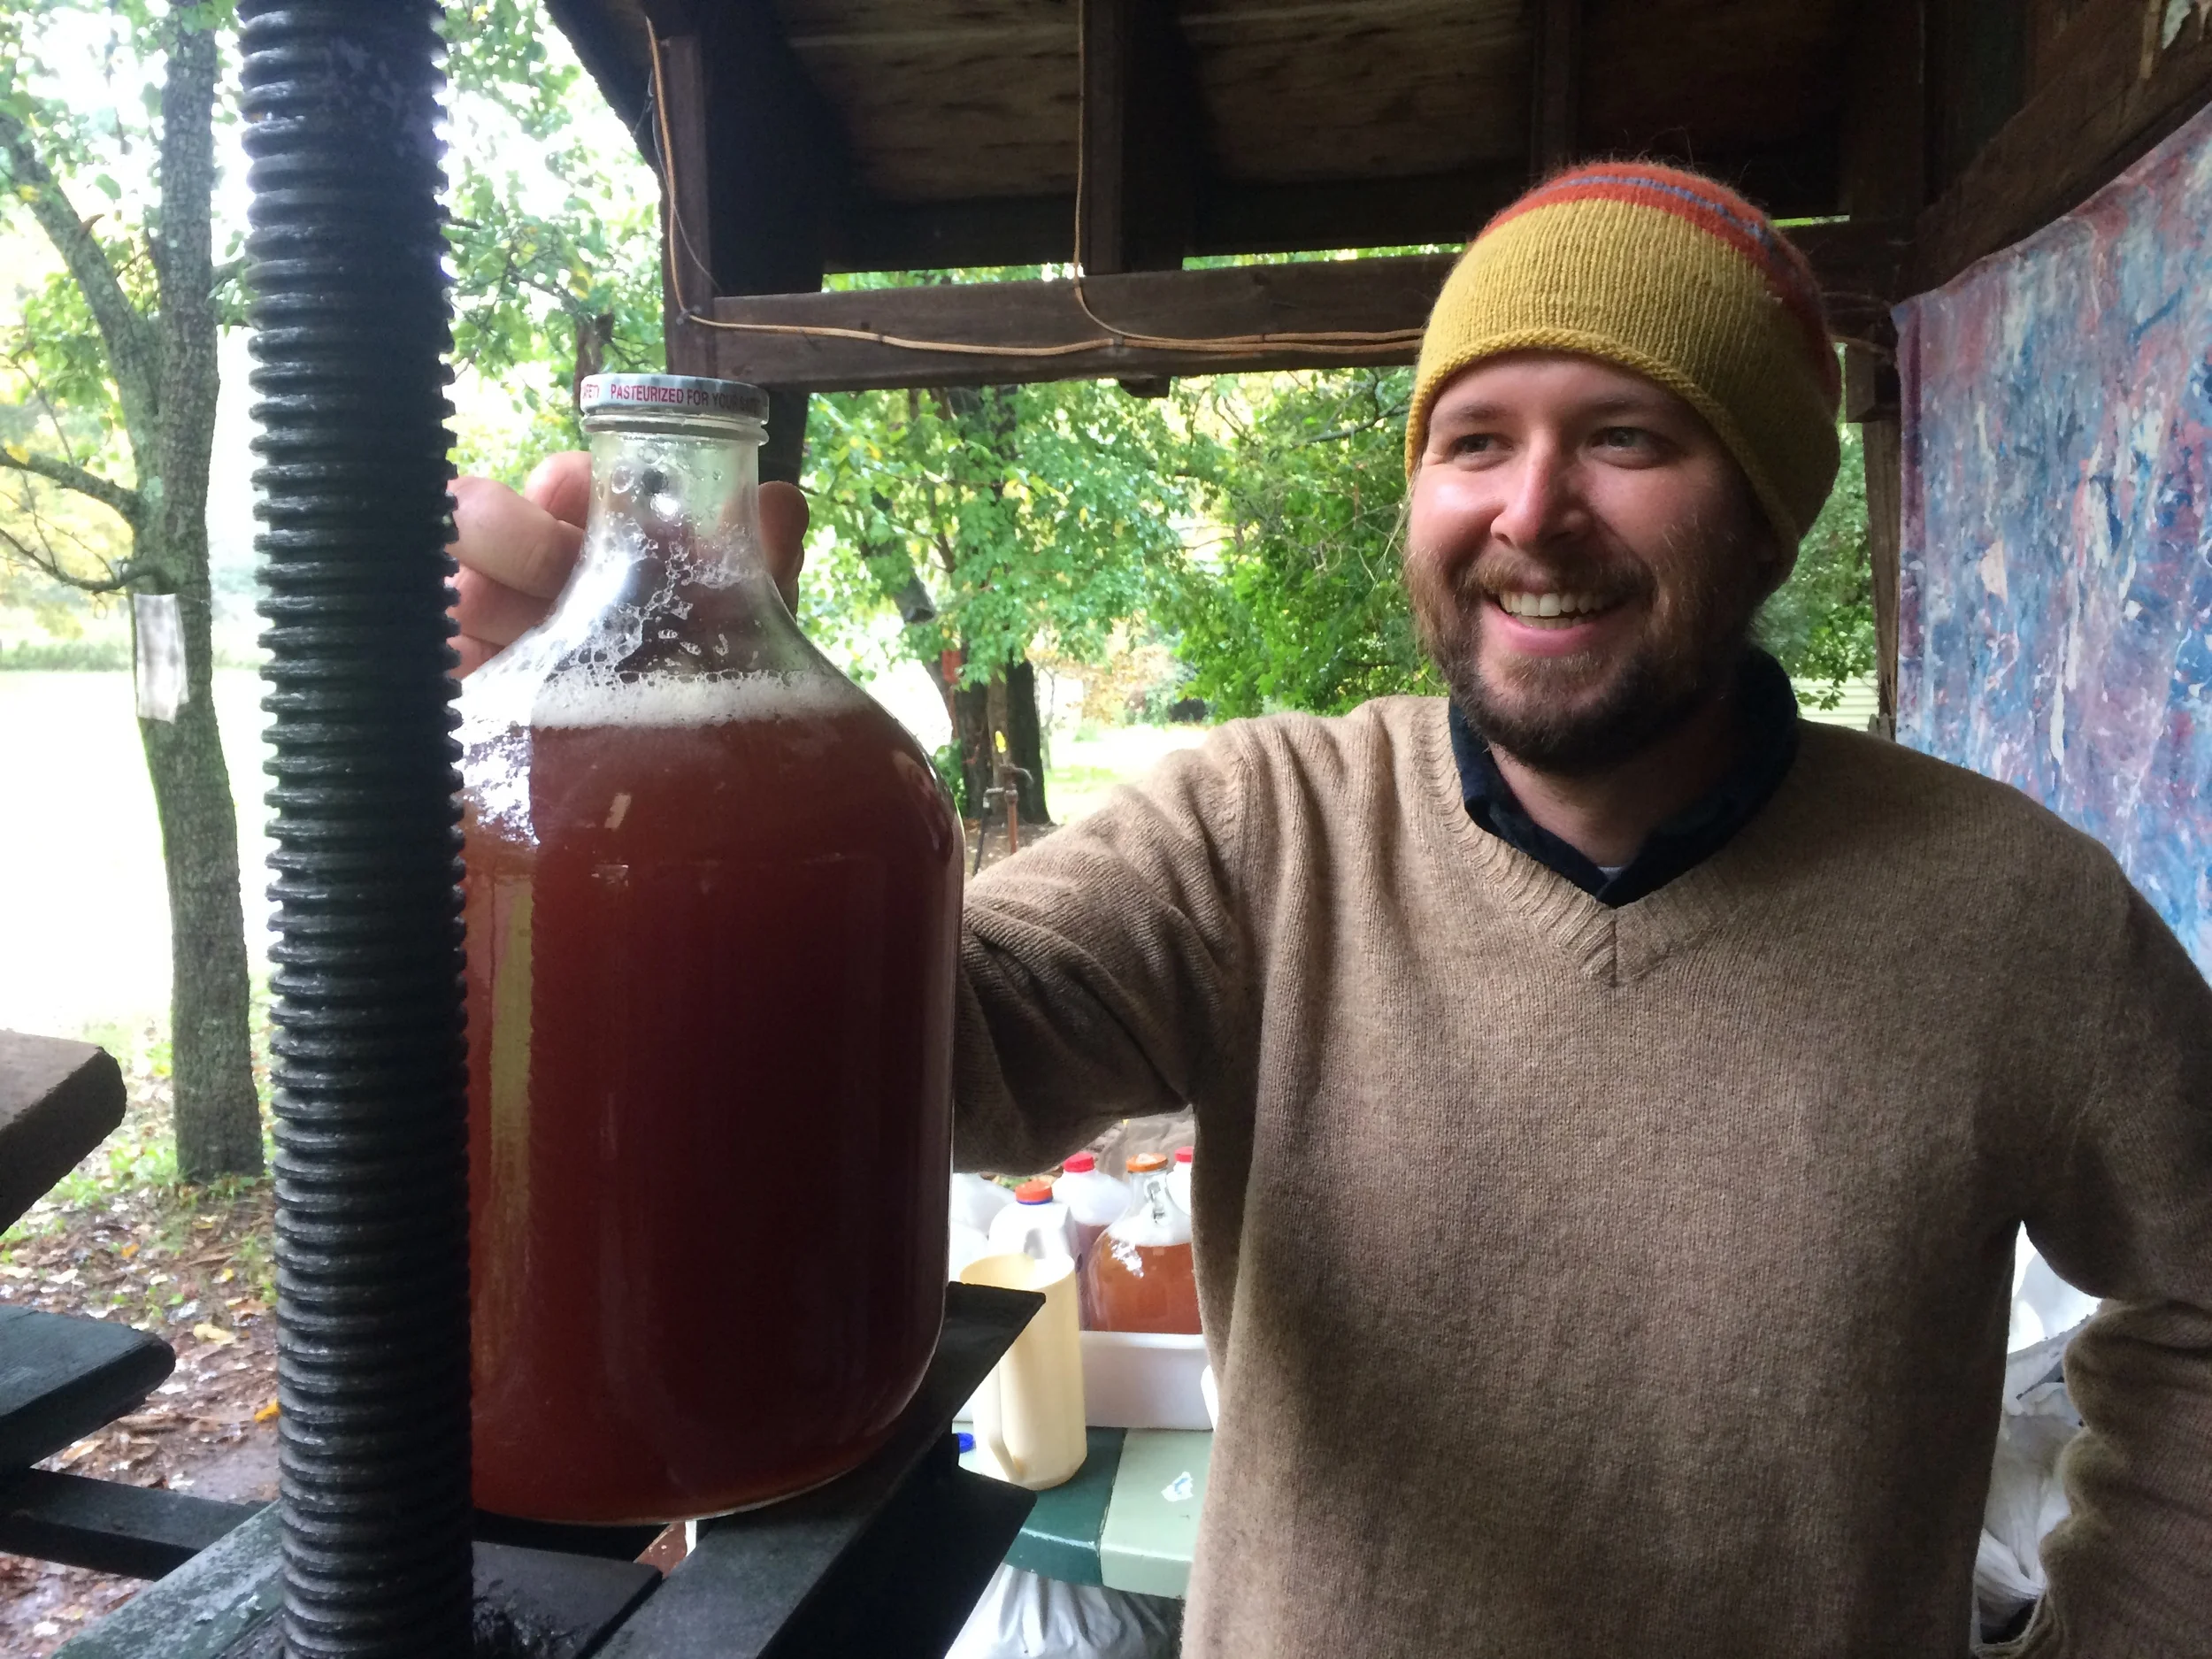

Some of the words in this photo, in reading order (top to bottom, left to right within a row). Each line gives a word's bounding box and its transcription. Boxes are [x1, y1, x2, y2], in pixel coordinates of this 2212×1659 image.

[611, 384, 684, 403] PASTEURIZED
[687, 388, 709, 406] FOR
[711, 392, 739, 412] YOUR
